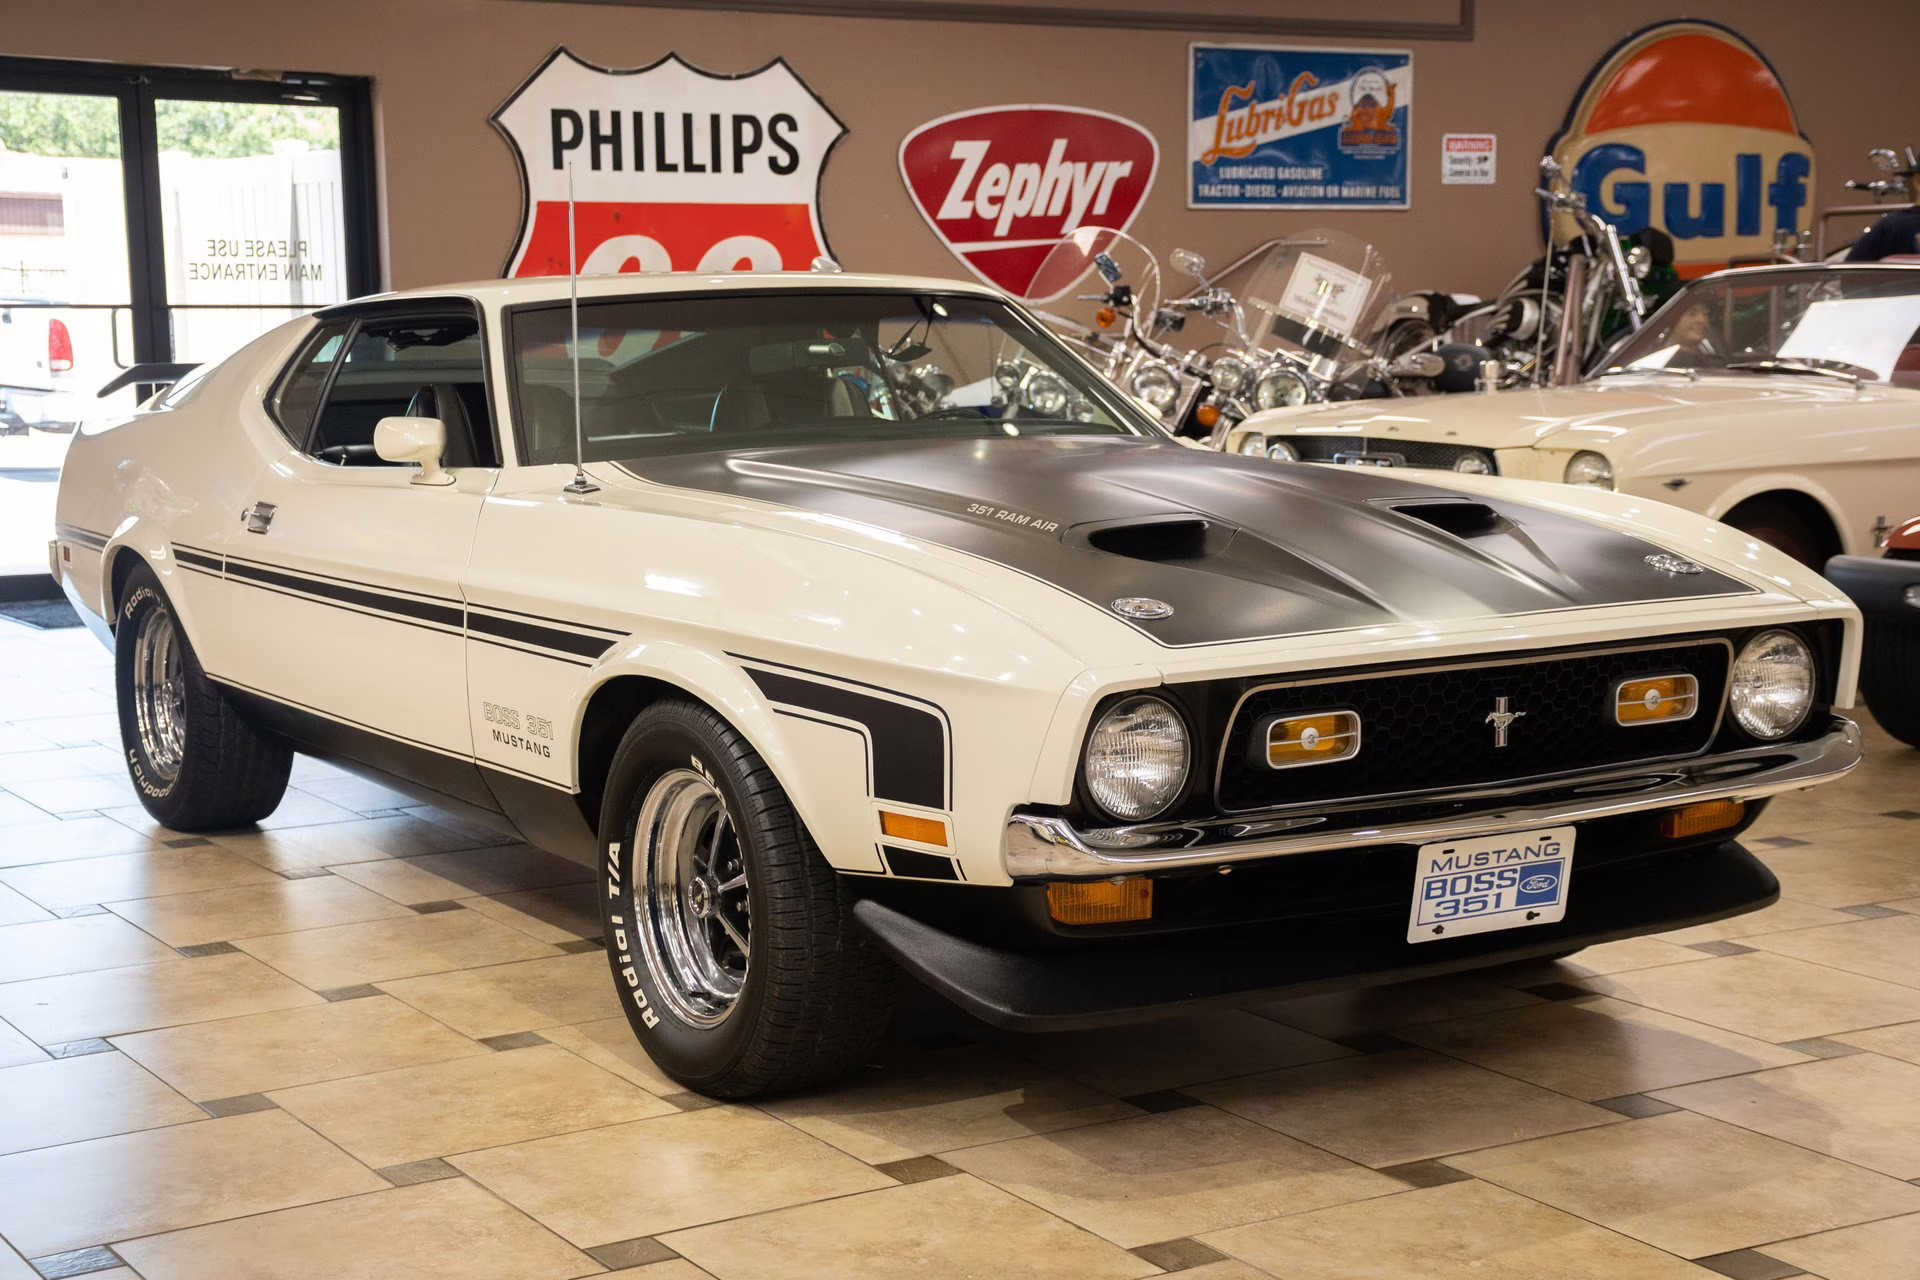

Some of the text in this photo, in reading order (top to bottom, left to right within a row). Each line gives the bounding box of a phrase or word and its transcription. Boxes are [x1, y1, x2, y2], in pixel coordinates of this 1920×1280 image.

[550, 108, 800, 175] PHILLIPS
[936, 138, 1134, 237] Zephyr
[1219, 167, 1323, 180] LUBRICATED GASOLINE
[1326, 186, 1339, 198] OR
[1341, 186, 1377, 198] MARINE
[1378, 186, 1400, 198] FUEL
[1572, 143, 1811, 239] Gulf
[966, 503, 1059, 533] 351 RAM AIR
[124, 587, 154, 620] Radial
[483, 701, 554, 741] BOSS 351
[492, 728, 551, 758] MUSTANG
[1430, 842, 1561, 873] MUSTANG
[1424, 868, 1518, 900] BOSS
[1526, 877, 1549, 890] Ford
[1434, 892, 1502, 919] 351
[607, 842, 661, 1030] Radial T/A
